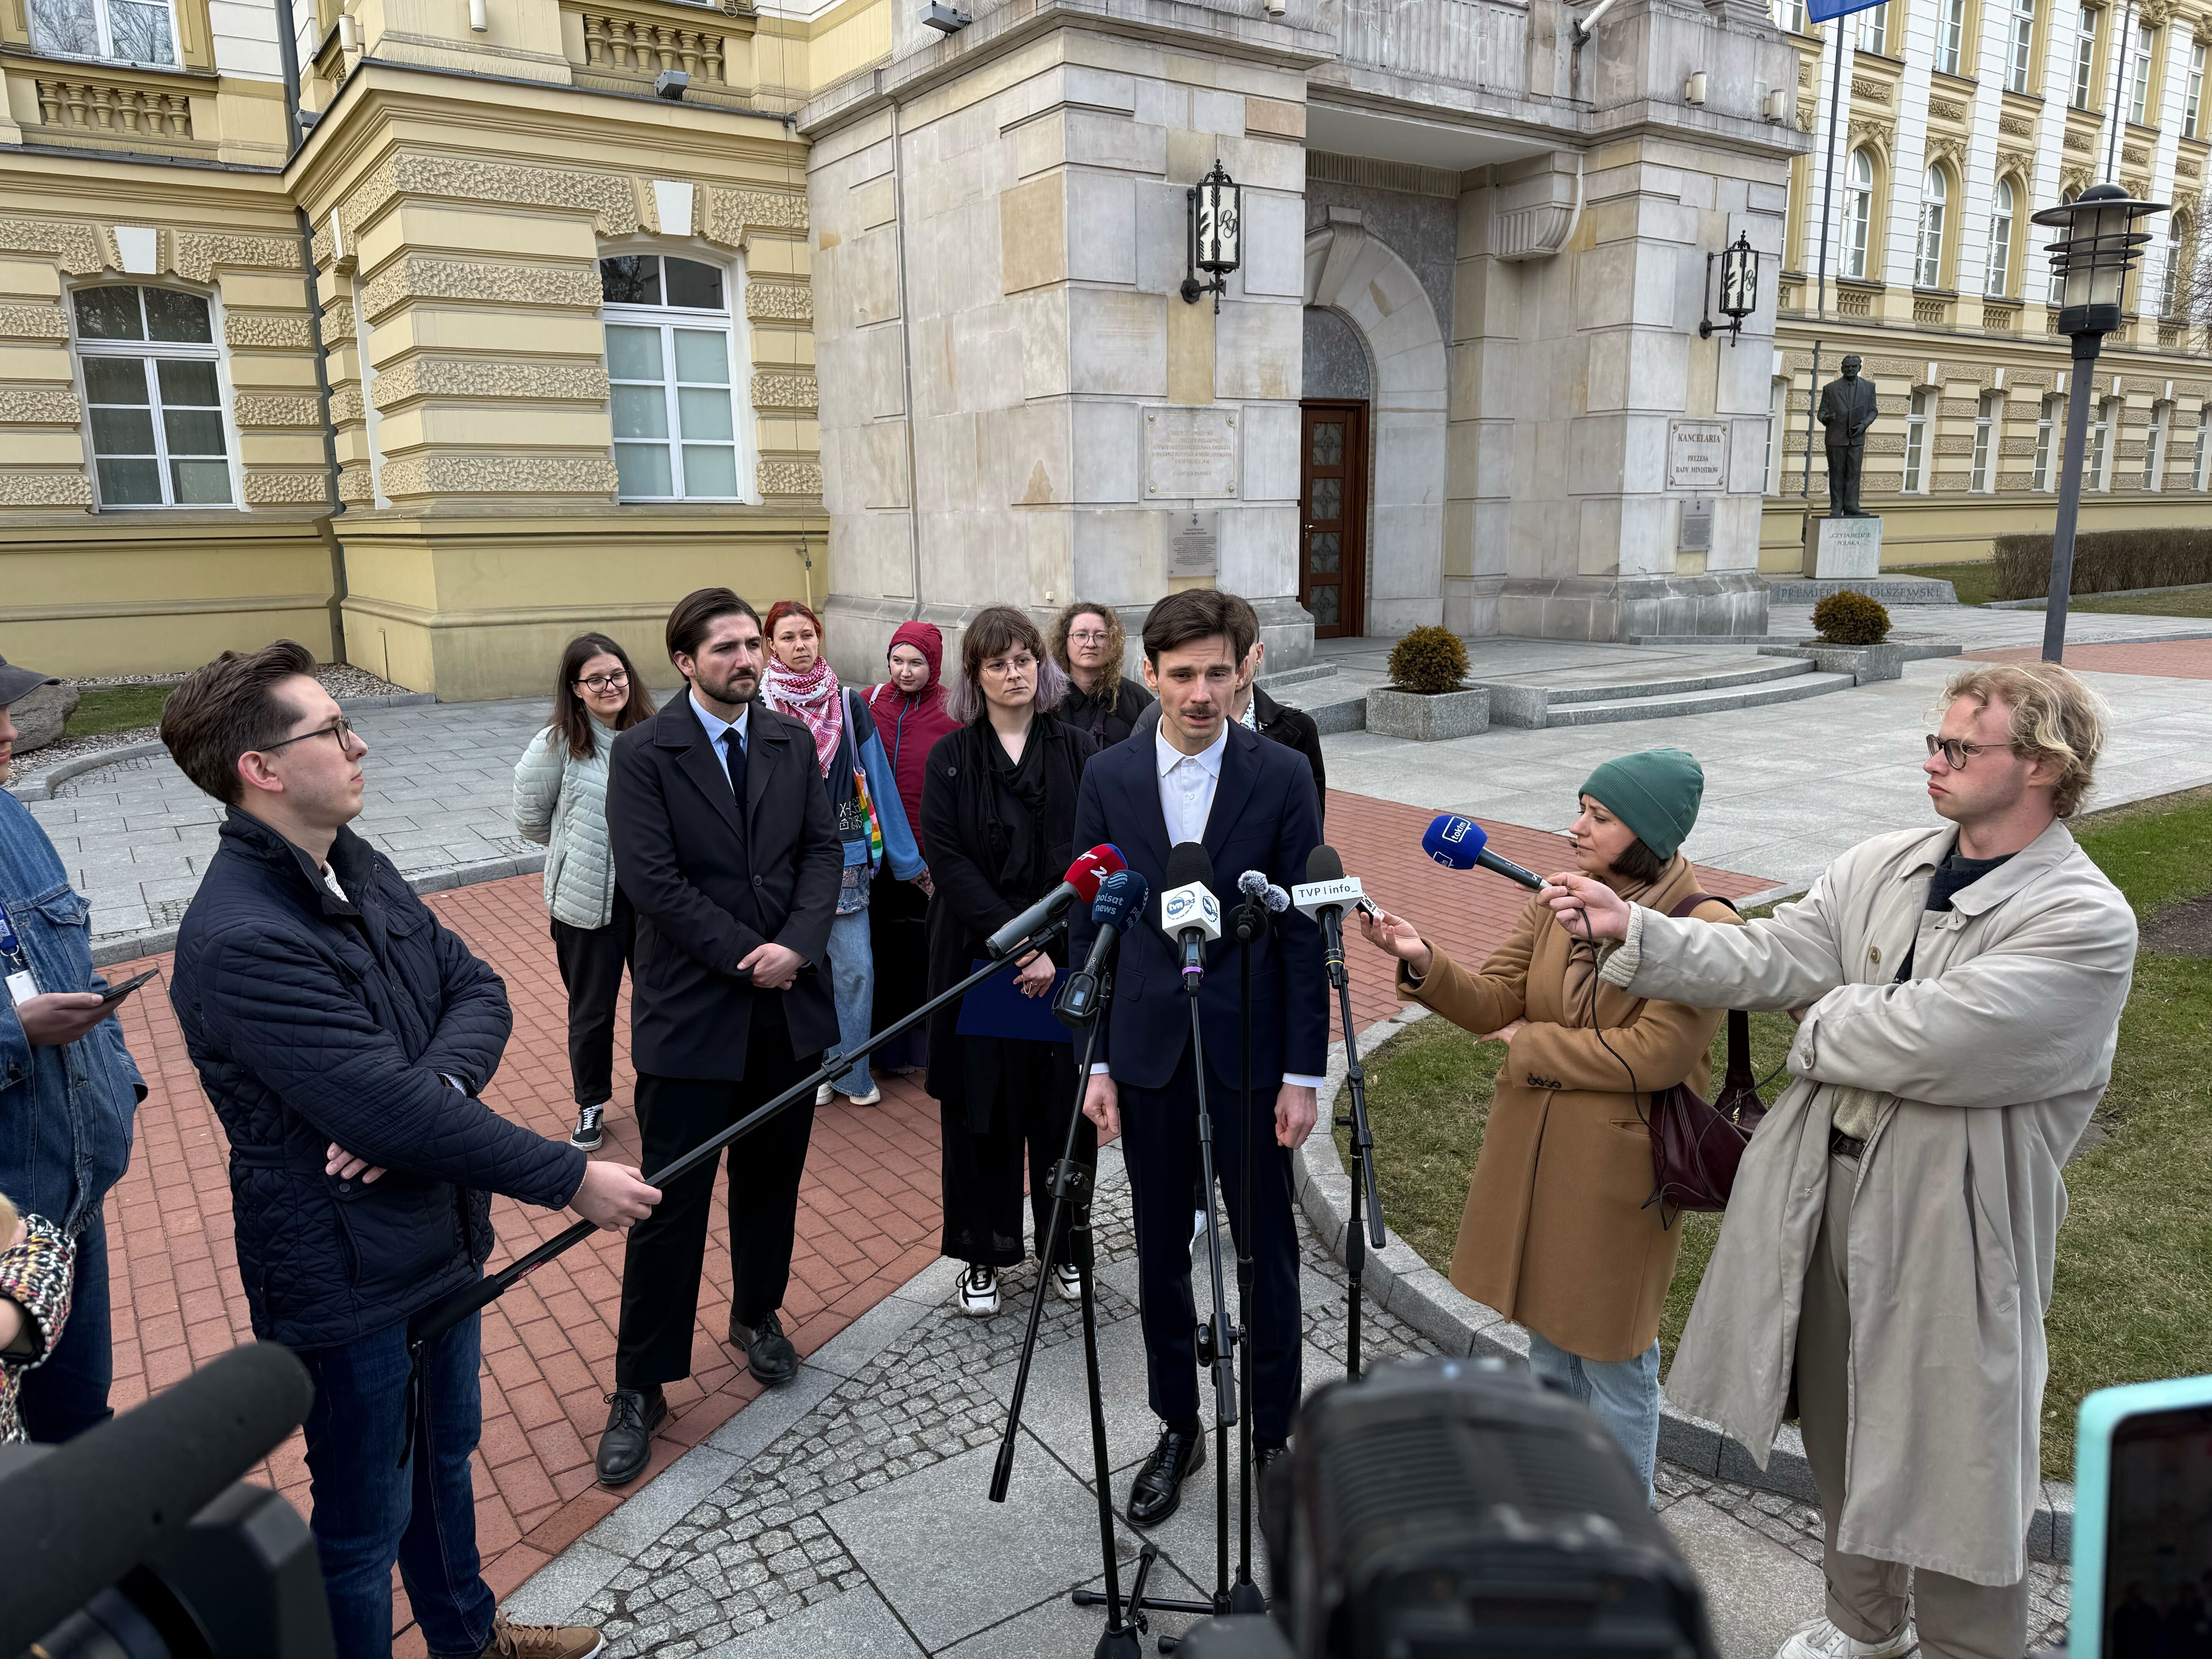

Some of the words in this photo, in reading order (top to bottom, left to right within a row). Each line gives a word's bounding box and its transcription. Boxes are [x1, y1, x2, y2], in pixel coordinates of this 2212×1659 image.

[1678, 433, 1720, 443] KANCELARIA
[1691, 465, 1718, 473] MINISTRÓW
[1781, 588, 1831, 597] PREMIER
[1870, 588, 1939, 597] OLSZEWSKI
[1298, 888, 1320, 897] TVP
[1095, 893, 1123, 906] polsat
[1095, 904, 1116, 915] news
